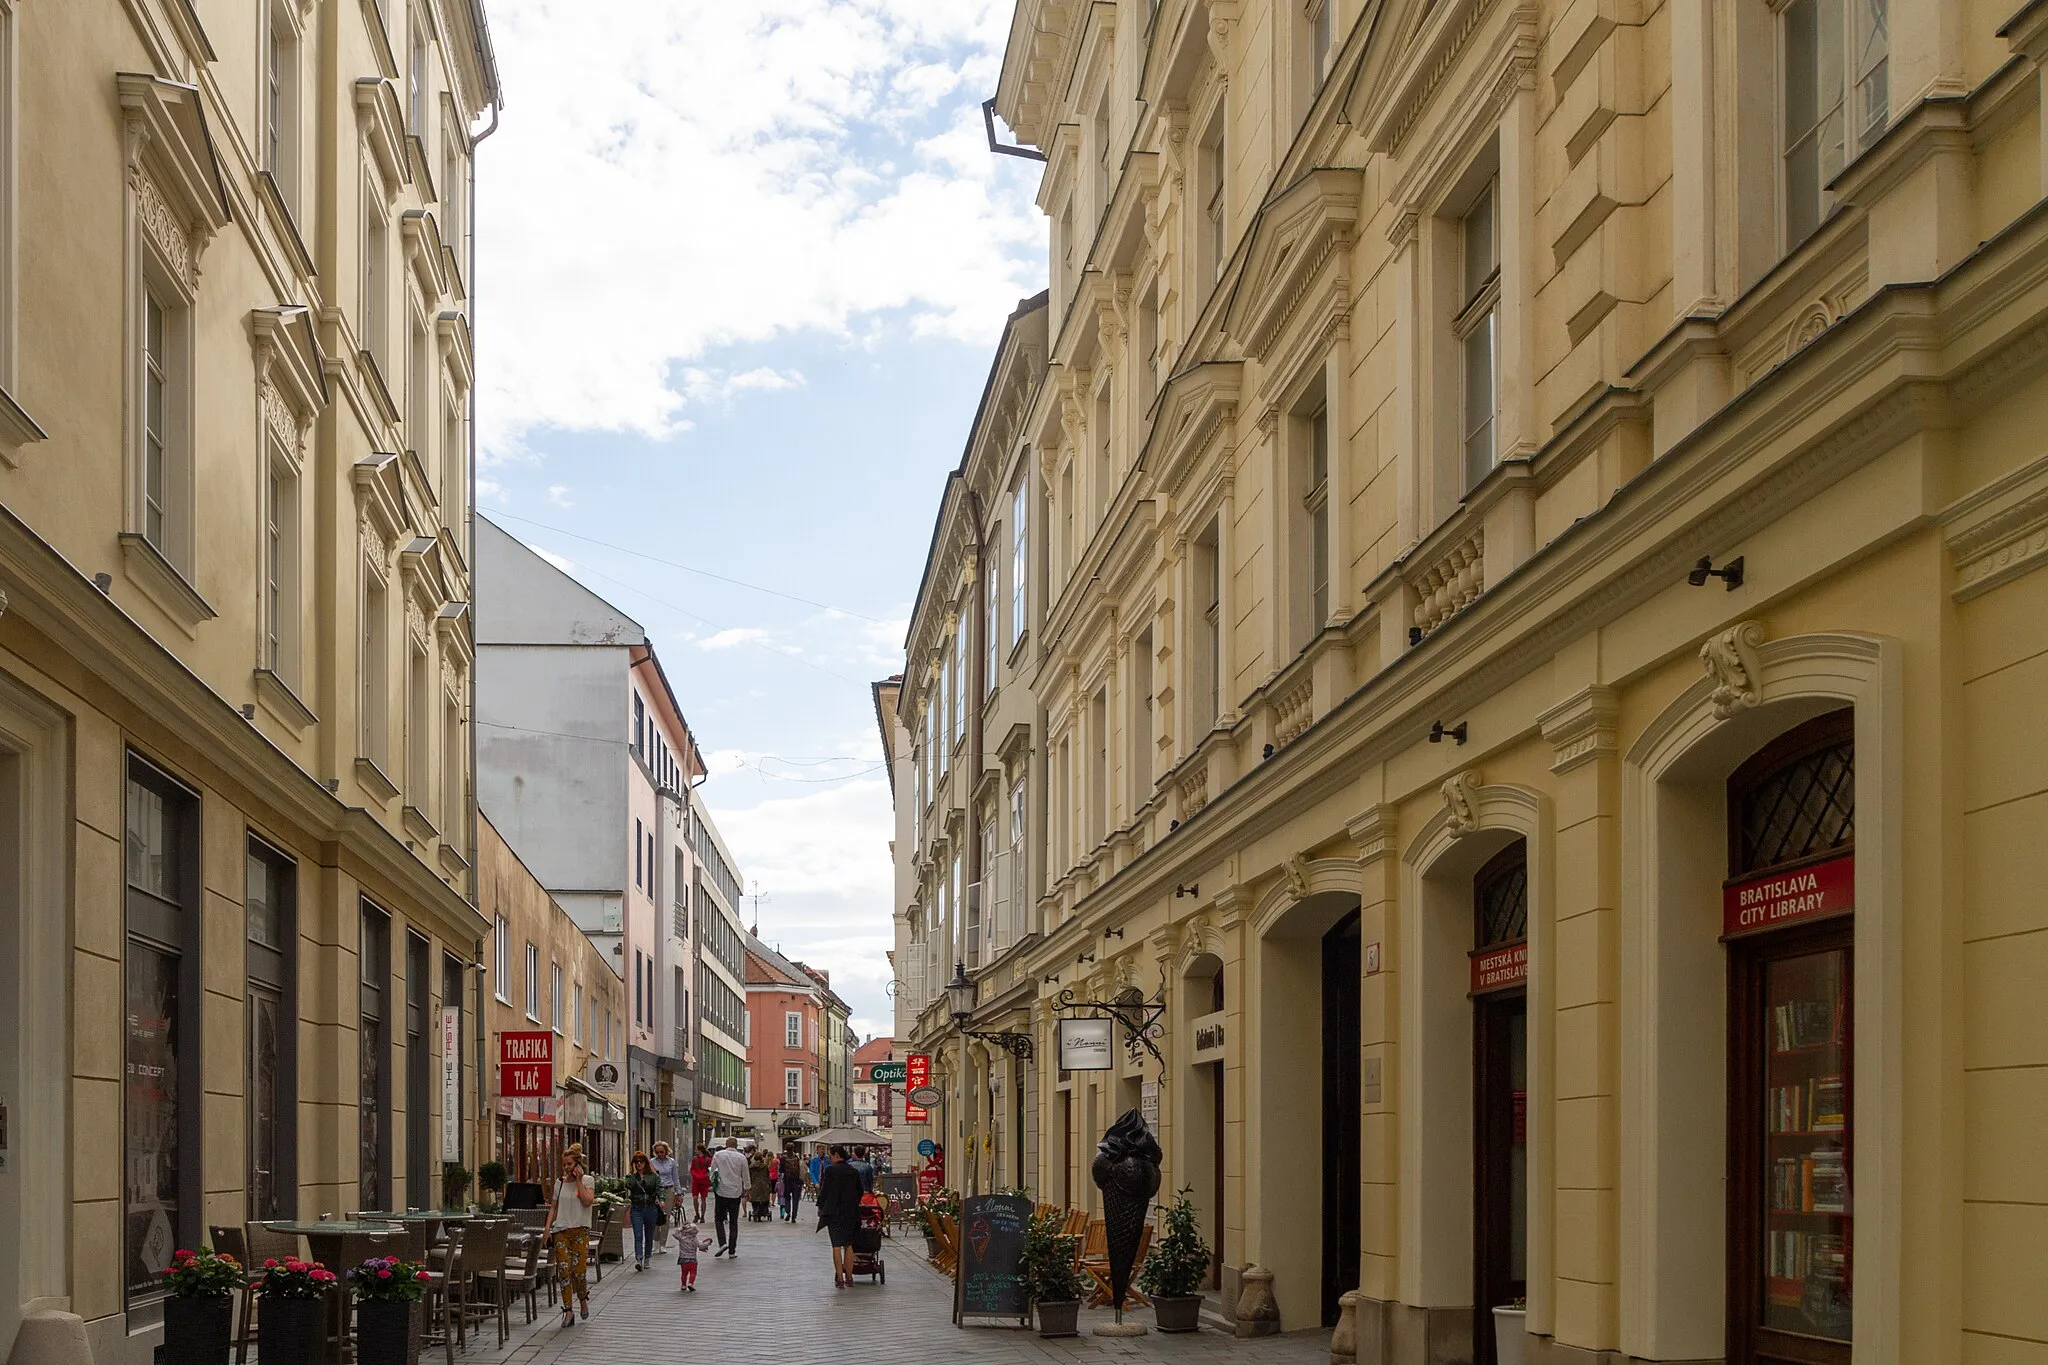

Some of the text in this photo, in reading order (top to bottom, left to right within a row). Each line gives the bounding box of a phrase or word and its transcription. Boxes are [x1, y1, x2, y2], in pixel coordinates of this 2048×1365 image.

[1740, 873, 1817, 906] BRATISLAVA
[1740, 892, 1825, 925] CITY LIBRARY
[1480, 949, 1527, 972] MESTSKÁ KNI
[1480, 974, 1486, 986] V
[506, 1039, 548, 1059] TRAFIKA
[138, 1064, 165, 1077] CONCEPT
[514, 1067, 539, 1091] TLAČ
[985, 1198, 1015, 1213] Nonni
